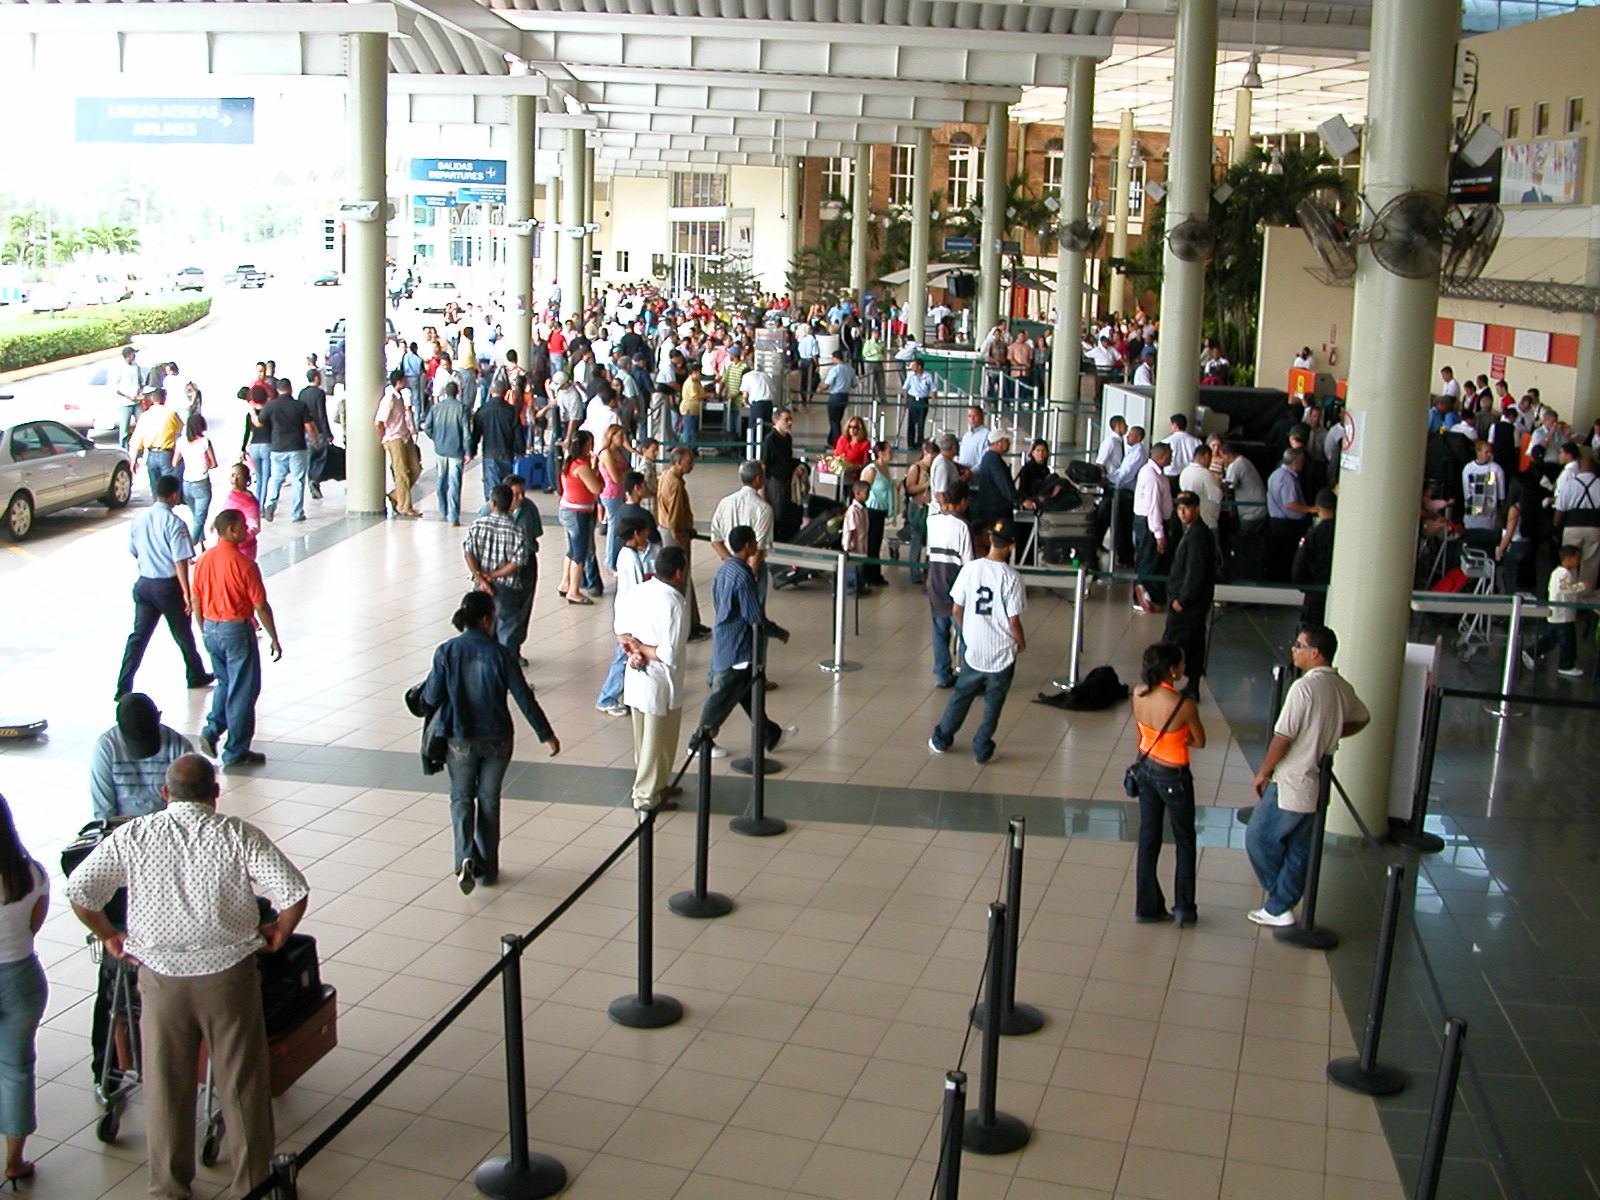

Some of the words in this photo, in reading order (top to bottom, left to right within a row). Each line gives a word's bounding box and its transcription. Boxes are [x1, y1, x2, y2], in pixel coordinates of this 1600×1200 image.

[132, 122, 198, 136] AIRLINES
[437, 161, 474, 171] SALIDAS
[428, 170, 484, 181] DEPARTURES
[975, 585, 994, 616] 2
